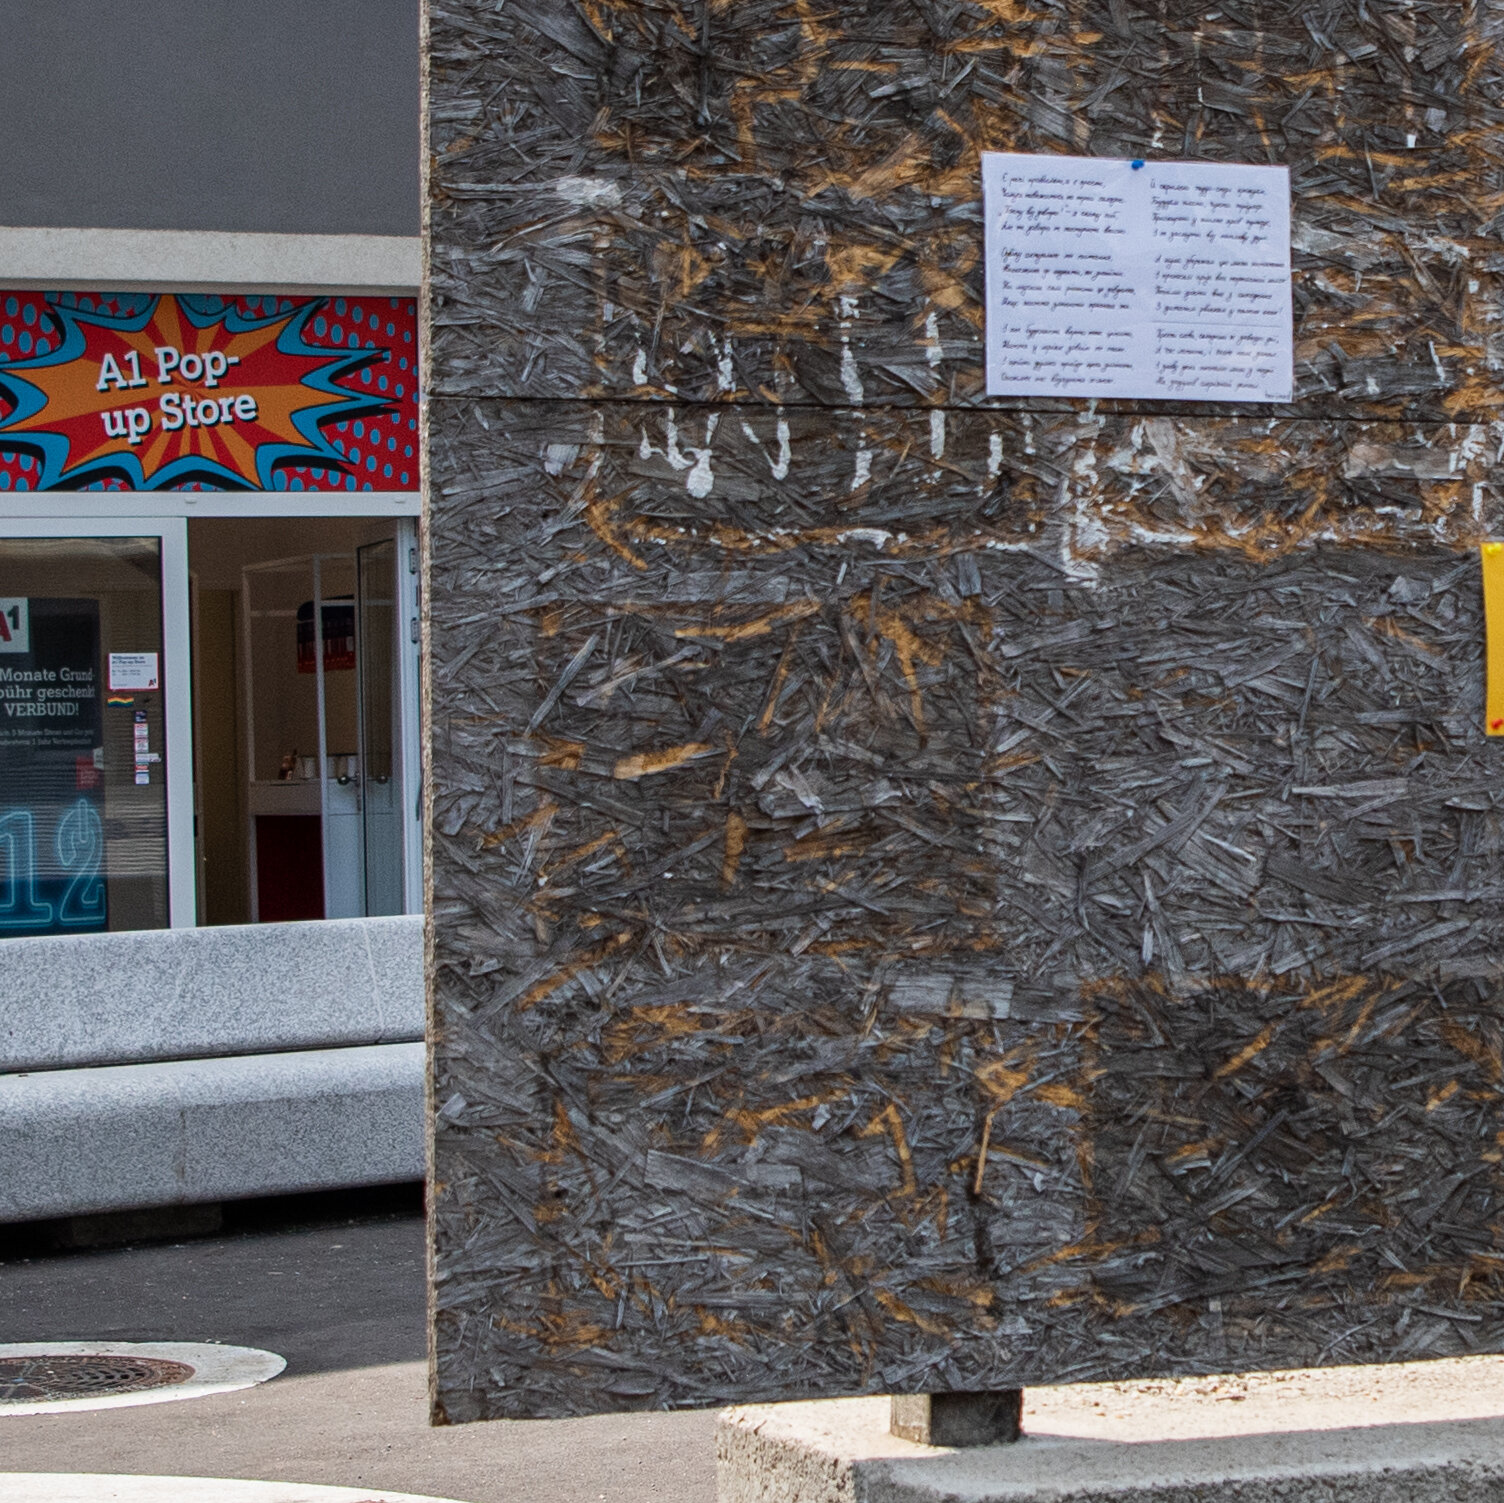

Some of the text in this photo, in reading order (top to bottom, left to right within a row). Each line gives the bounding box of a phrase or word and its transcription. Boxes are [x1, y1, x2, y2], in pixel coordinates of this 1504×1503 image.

[96, 346, 240, 392] A1 Pop-
[101, 392, 258, 445] up Store
[0, 668, 56, 681] Monate
[5, 702, 79, 716] VERBUND!
